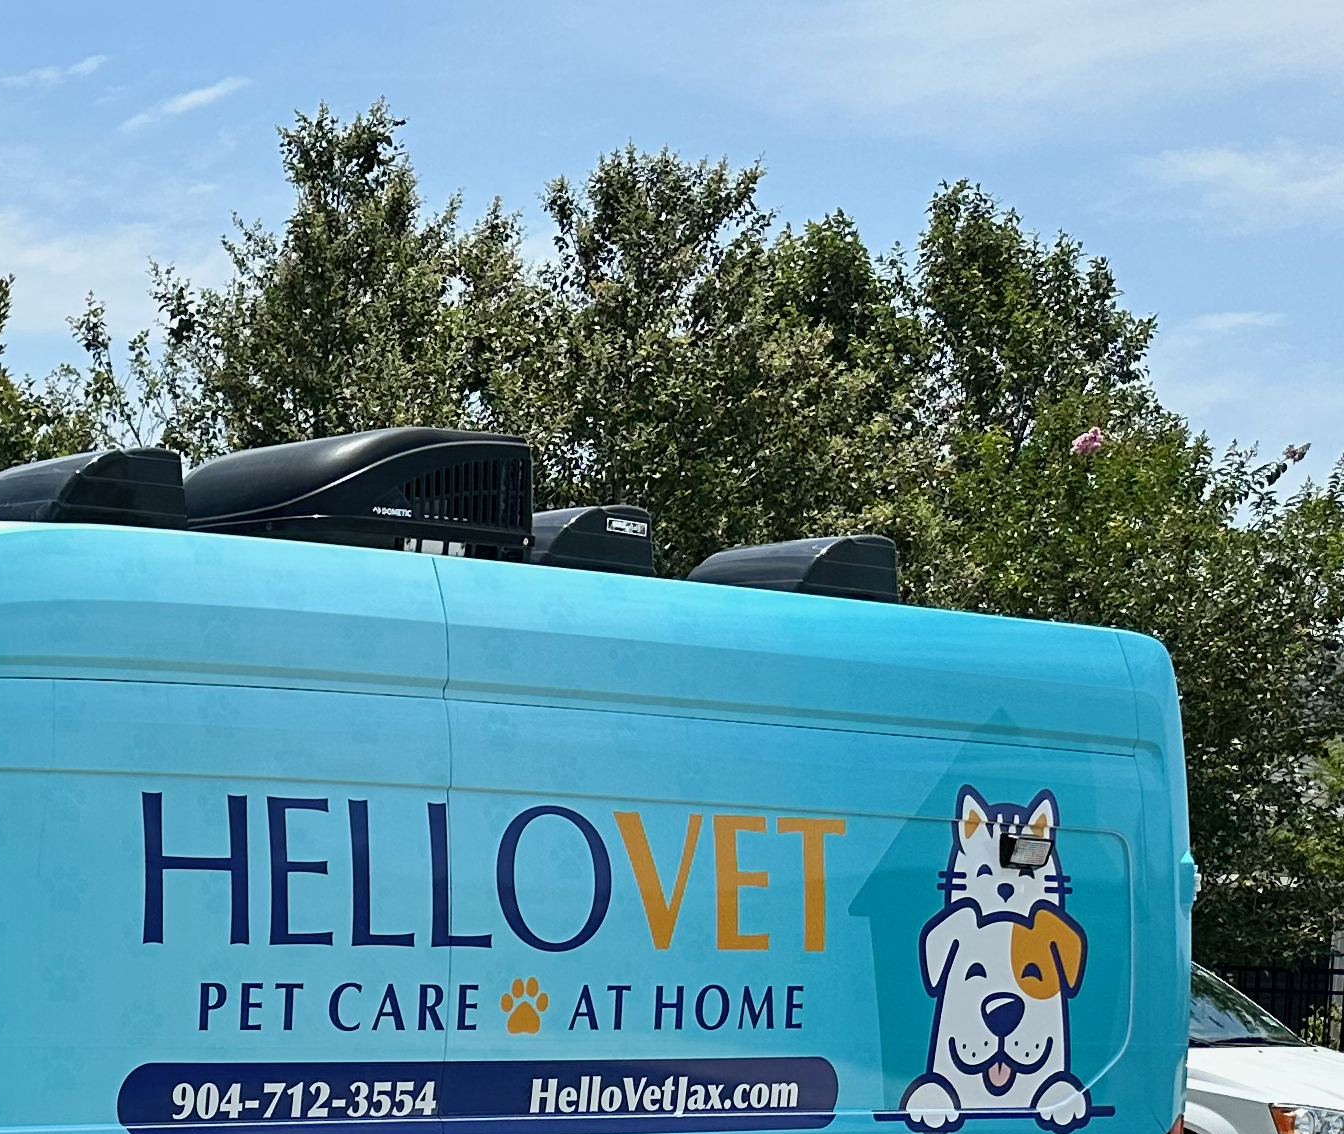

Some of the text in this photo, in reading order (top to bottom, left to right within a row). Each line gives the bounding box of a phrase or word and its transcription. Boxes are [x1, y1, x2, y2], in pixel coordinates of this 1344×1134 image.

[141, 791, 846, 953] HELLOVET
[198, 982, 479, 1032] PET CARE
[568, 984, 805, 1031] AT HOME
[171, 1075, 799, 1119] 904-712-3554 HelloVetJax.com
